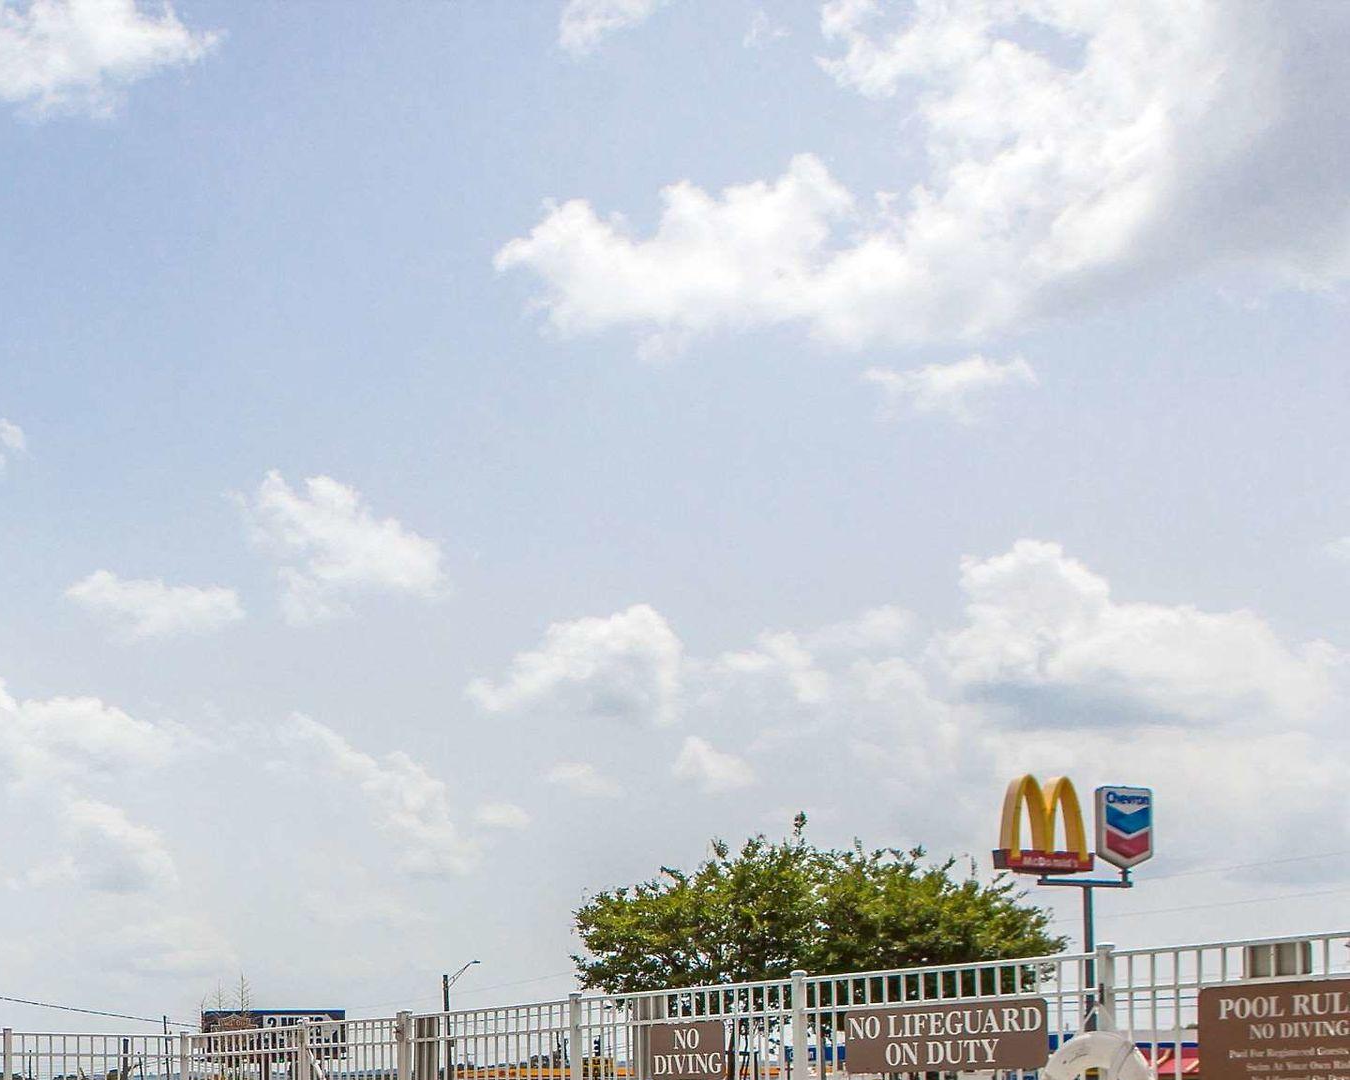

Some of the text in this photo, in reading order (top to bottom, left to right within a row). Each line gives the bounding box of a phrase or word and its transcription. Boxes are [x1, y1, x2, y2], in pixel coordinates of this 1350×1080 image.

[1219, 992, 1350, 1020] POOL RUL
[848, 1006, 1042, 1040] NO LIFEGUARD
[1249, 1020, 1350, 1040] NO DIVING
[674, 1028, 700, 1050] NO
[653, 1052, 722, 1075] DIVING
[885, 1038, 999, 1066] ON DUTY
